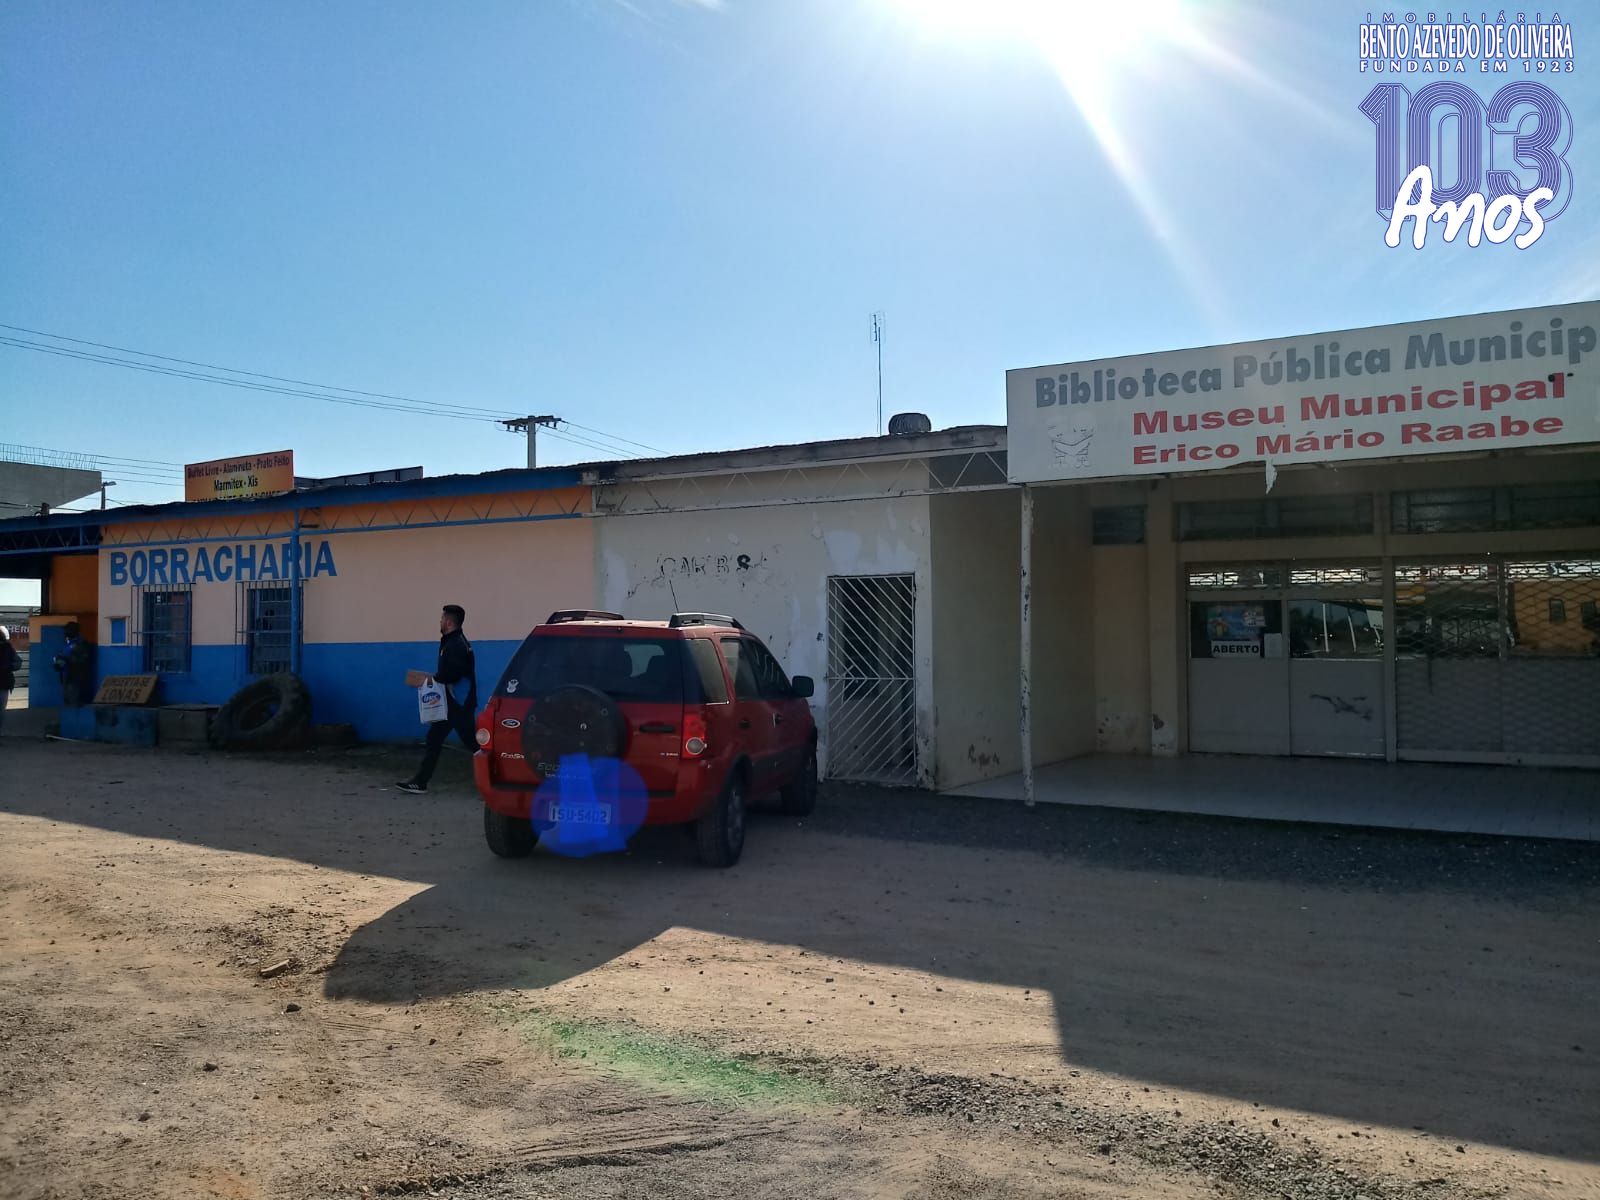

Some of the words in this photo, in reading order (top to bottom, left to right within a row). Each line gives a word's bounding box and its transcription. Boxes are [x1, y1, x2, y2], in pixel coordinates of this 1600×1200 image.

[1036, 368, 1222, 408] Biblioteca
[1233, 342, 1391, 389] Pública
[1133, 406, 1285, 435] Museu
[1300, 372, 1566, 420] Municipal
[1133, 443, 1240, 464] Erico
[1256, 431, 1385, 456] Mário
[1401, 416, 1564, 445] Raabe
[214, 477, 243, 491] Marmitex
[248, 475, 259, 488] Xis
[110, 541, 336, 586] BORRACHARIA
[1213, 644, 1259, 654] ABERTO
